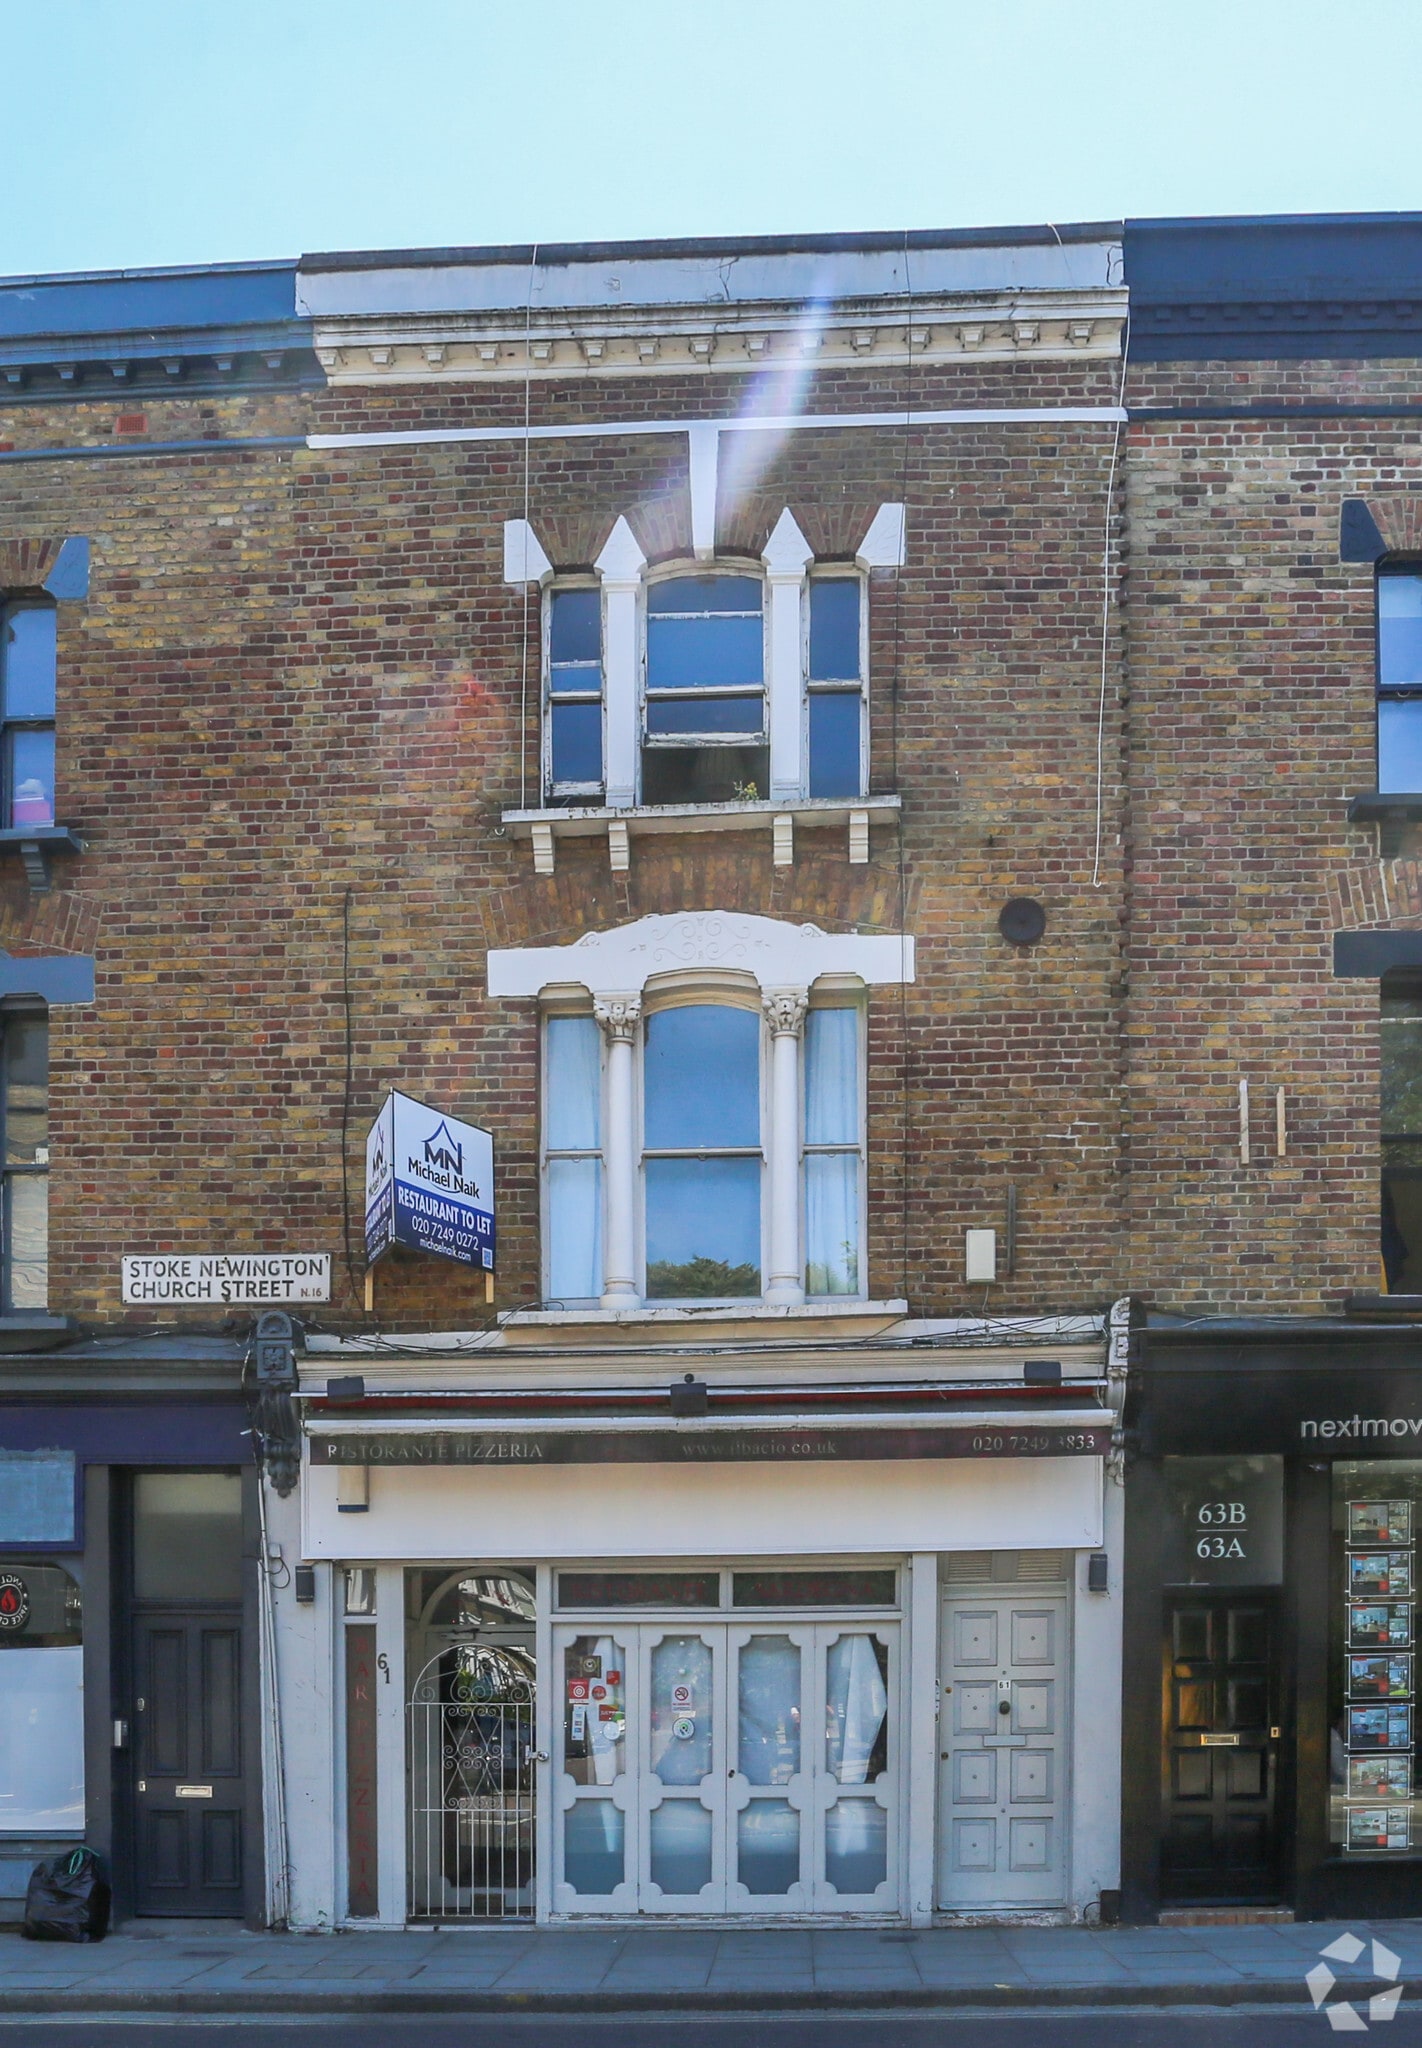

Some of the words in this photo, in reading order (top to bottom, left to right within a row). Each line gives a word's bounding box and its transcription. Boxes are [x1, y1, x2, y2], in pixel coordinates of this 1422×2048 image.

[424, 1141, 463, 1176] MN
[408, 1156, 450, 1188] Michael
[453, 1174, 480, 1199] Naik
[397, 1185, 459, 1225] RESTAURANT
[461, 1208, 475, 1230] TO
[476, 1214, 492, 1235] LET
[411, 1215, 430, 1235] 020
[431, 1222, 455, 1242] 7249
[456, 1230, 479, 1251] 0272
[130, 1260, 192, 1277] STOKE
[200, 1259, 323, 1277] NEWINGTON
[130, 1281, 211, 1298] CHURCH
[221, 1280, 295, 1298] STREET
[327, 1443, 448, 1459] RISTORANTE
[456, 1443, 543, 1458] PIZZERIA
[972, 1435, 1003, 1451] 020
[1009, 1435, 1049, 1451] 7249
[1198, 1502, 1246, 1524] 63B
[1196, 1537, 1246, 1558] 63A
[377, 1652, 391, 1685] 61
